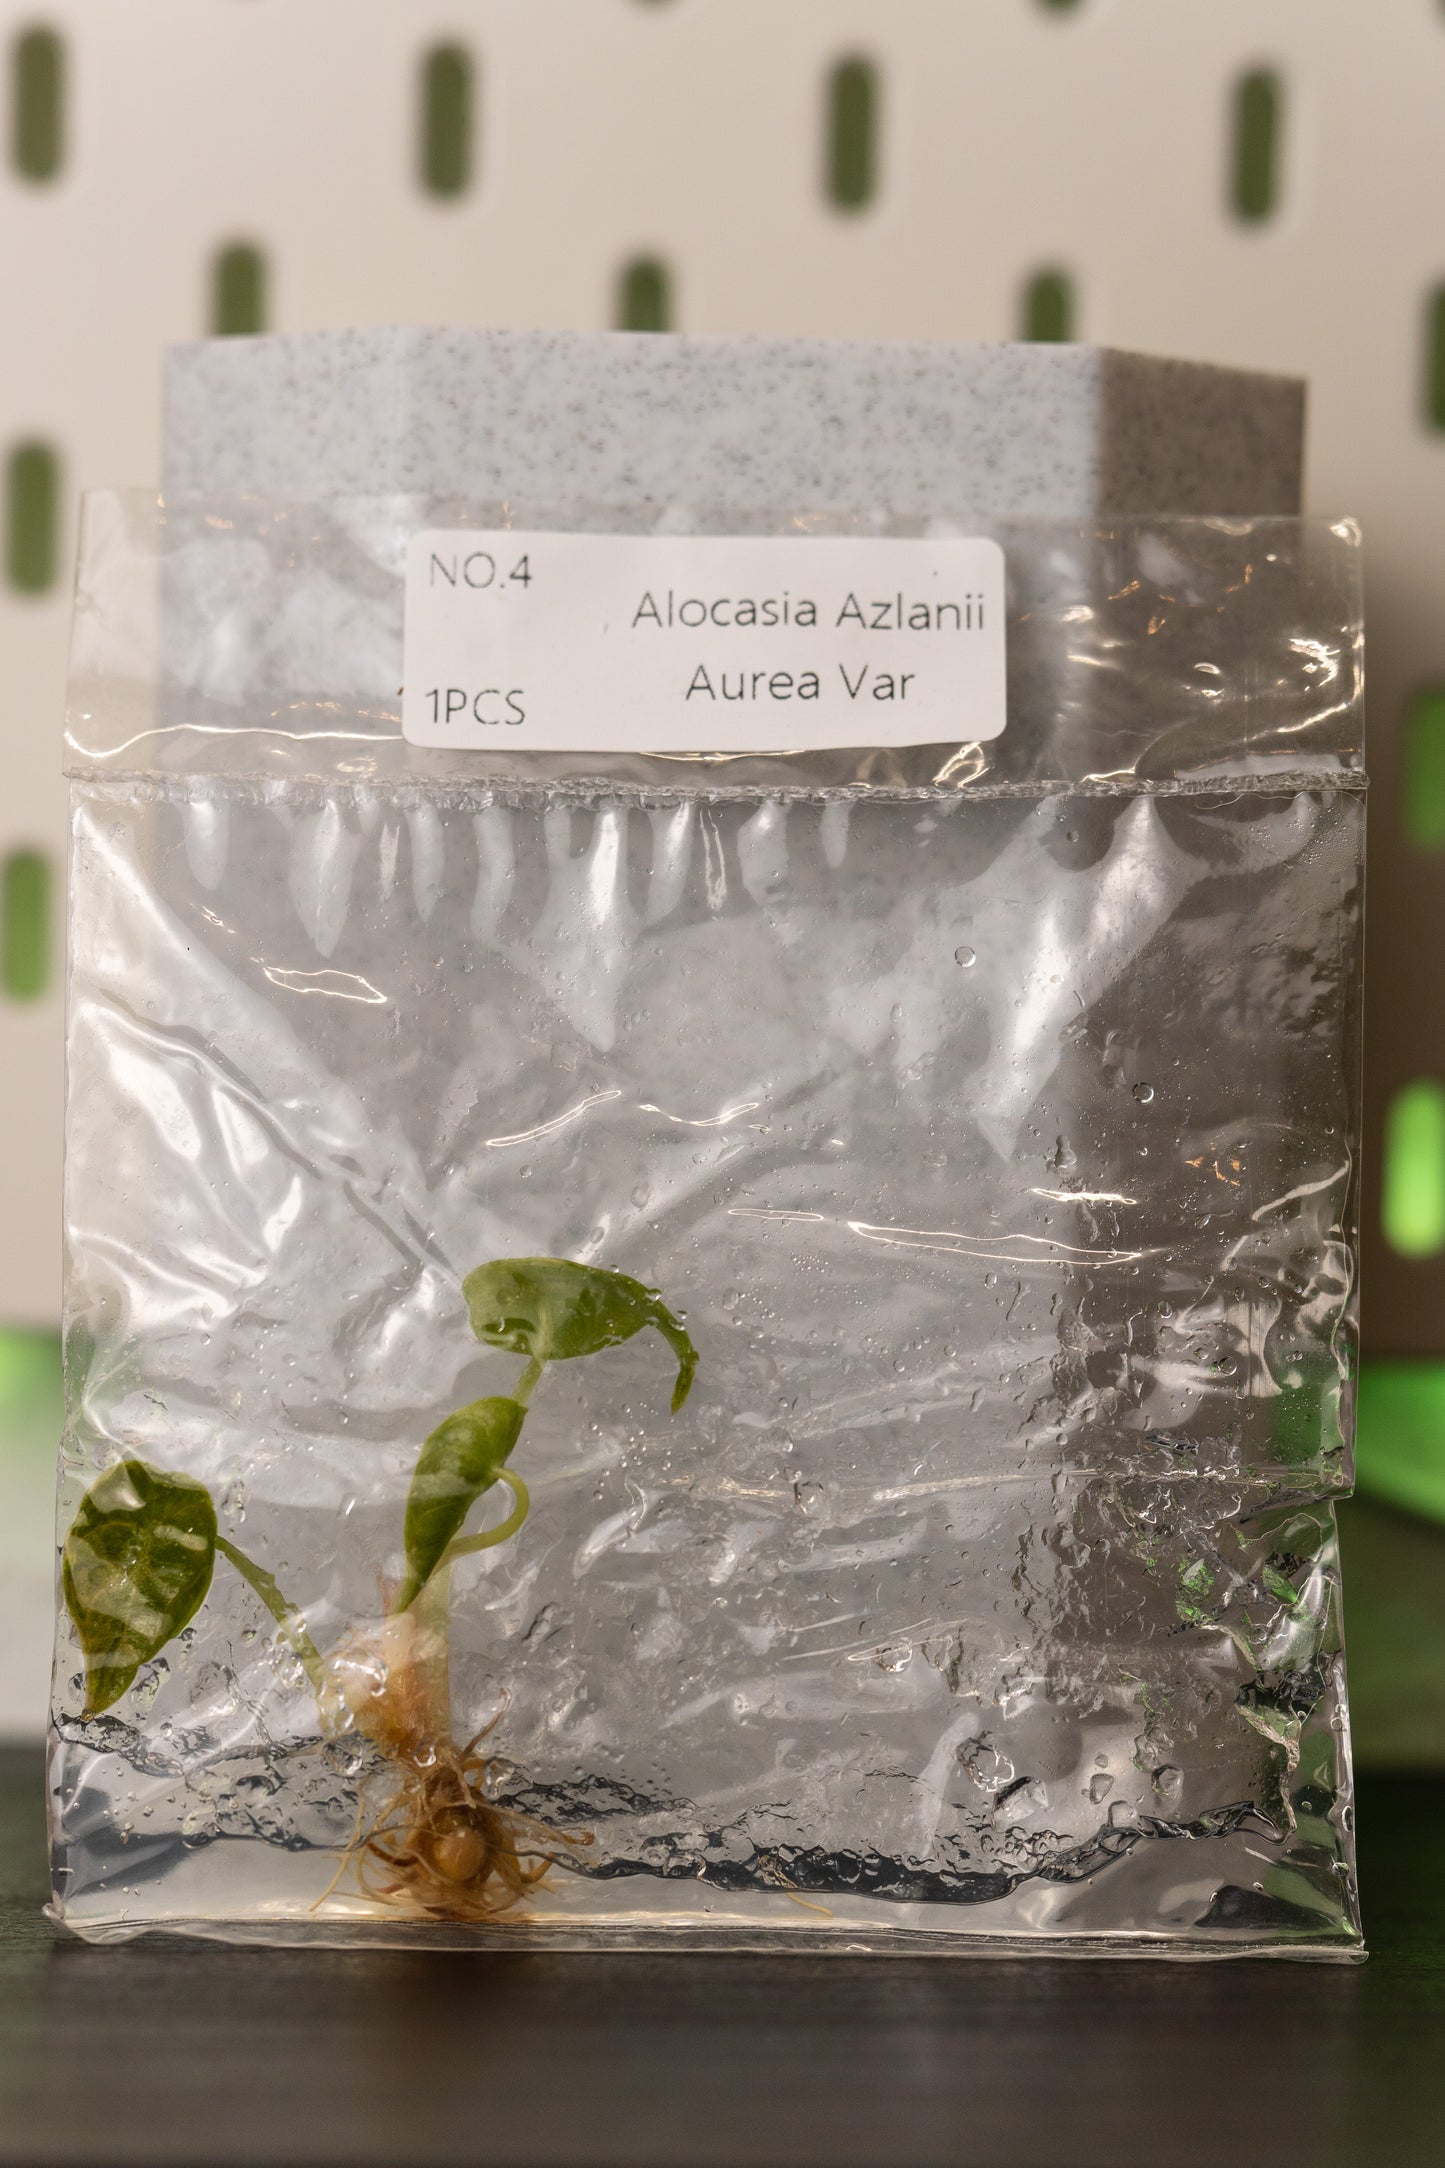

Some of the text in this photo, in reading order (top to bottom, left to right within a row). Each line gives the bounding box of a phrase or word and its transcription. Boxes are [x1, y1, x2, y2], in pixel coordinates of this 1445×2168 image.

[430, 551, 534, 589] NO.4
[631, 590, 984, 631] Alocasia Azlanii
[685, 663, 917, 701] Aurea Var
[425, 688, 527, 726] 1PCS
